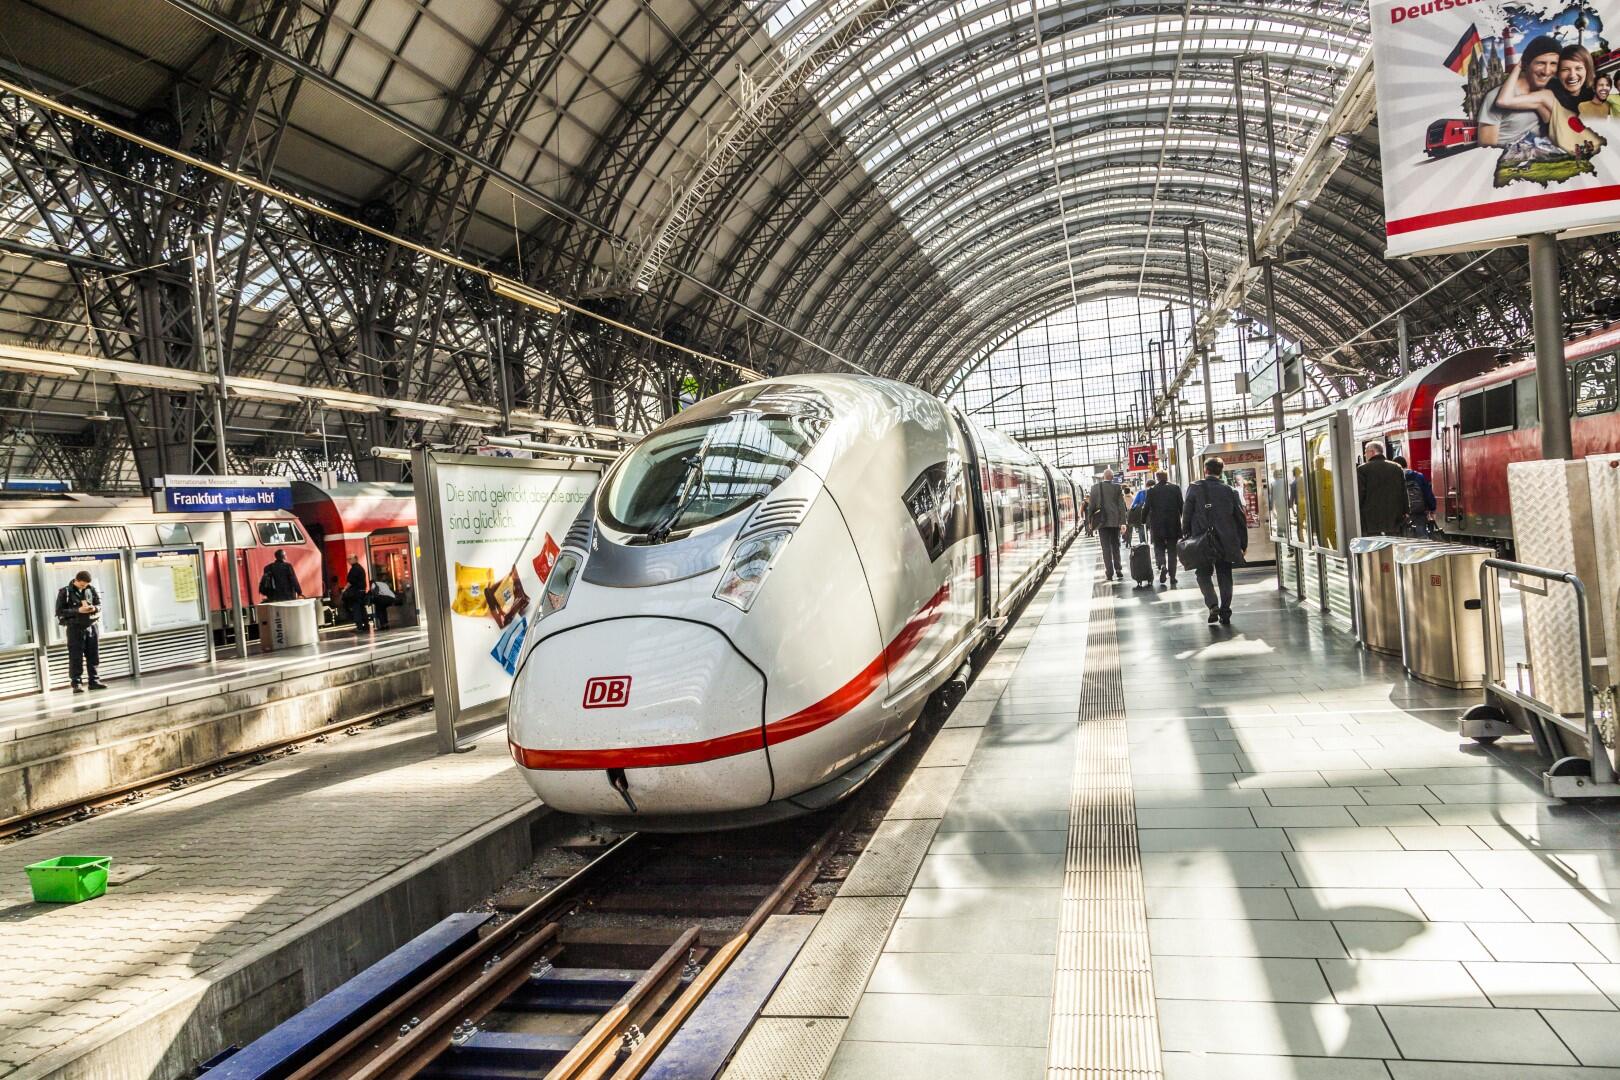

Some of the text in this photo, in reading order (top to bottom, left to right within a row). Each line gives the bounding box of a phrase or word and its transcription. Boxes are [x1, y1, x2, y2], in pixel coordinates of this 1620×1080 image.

[1136, 453, 1146, 464] A
[173, 492, 275, 505] Frankfurt am Main Hbf
[446, 483, 464, 502] Die
[468, 484, 487, 503] sind
[449, 509, 470, 530] sind
[274, 618, 283, 644] Abfall
[587, 680, 626, 704] DB
